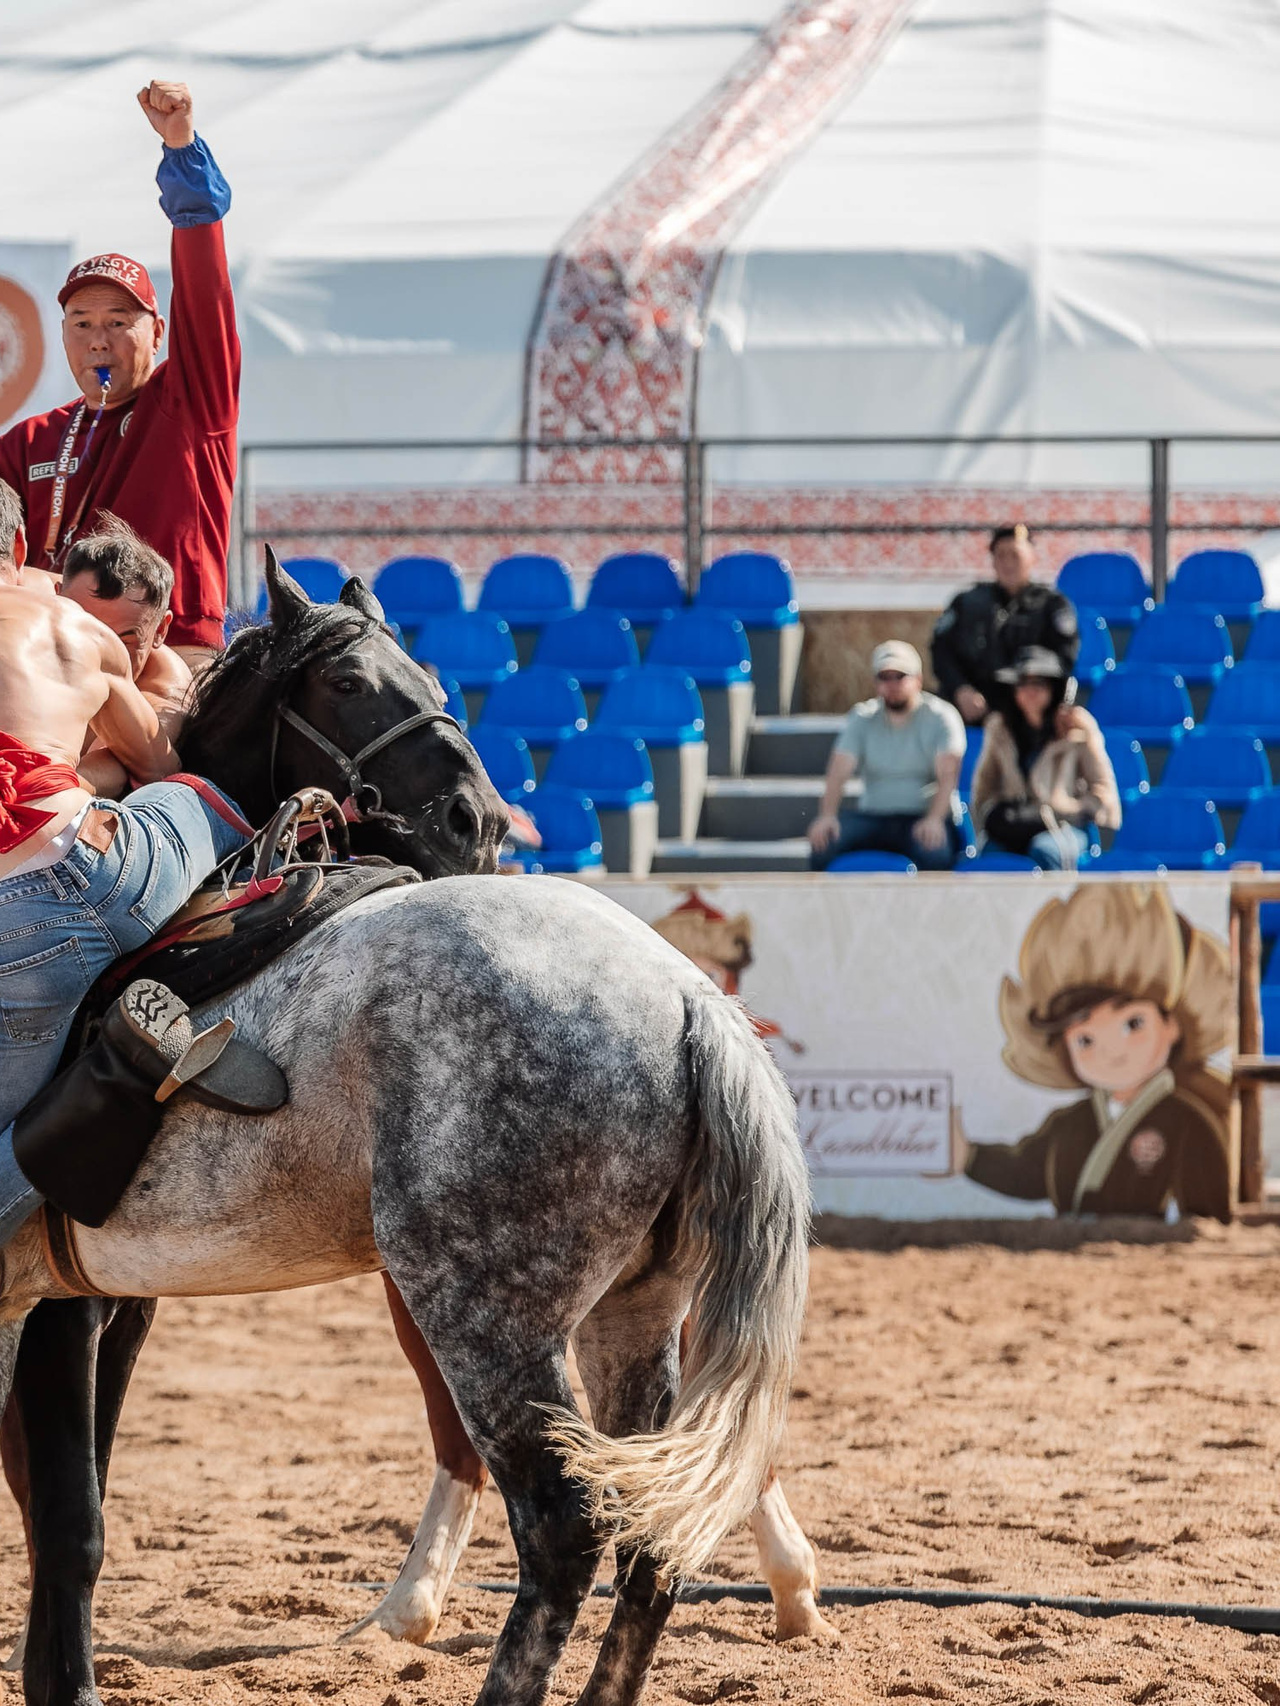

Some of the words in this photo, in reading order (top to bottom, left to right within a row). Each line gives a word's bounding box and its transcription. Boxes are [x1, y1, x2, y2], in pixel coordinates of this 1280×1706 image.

[77, 255, 140, 278] KYRGYZ
[57, 435, 75, 472] NOMAD
[32, 461, 75, 477] REFEE
[52, 475, 66, 518] WORLD
